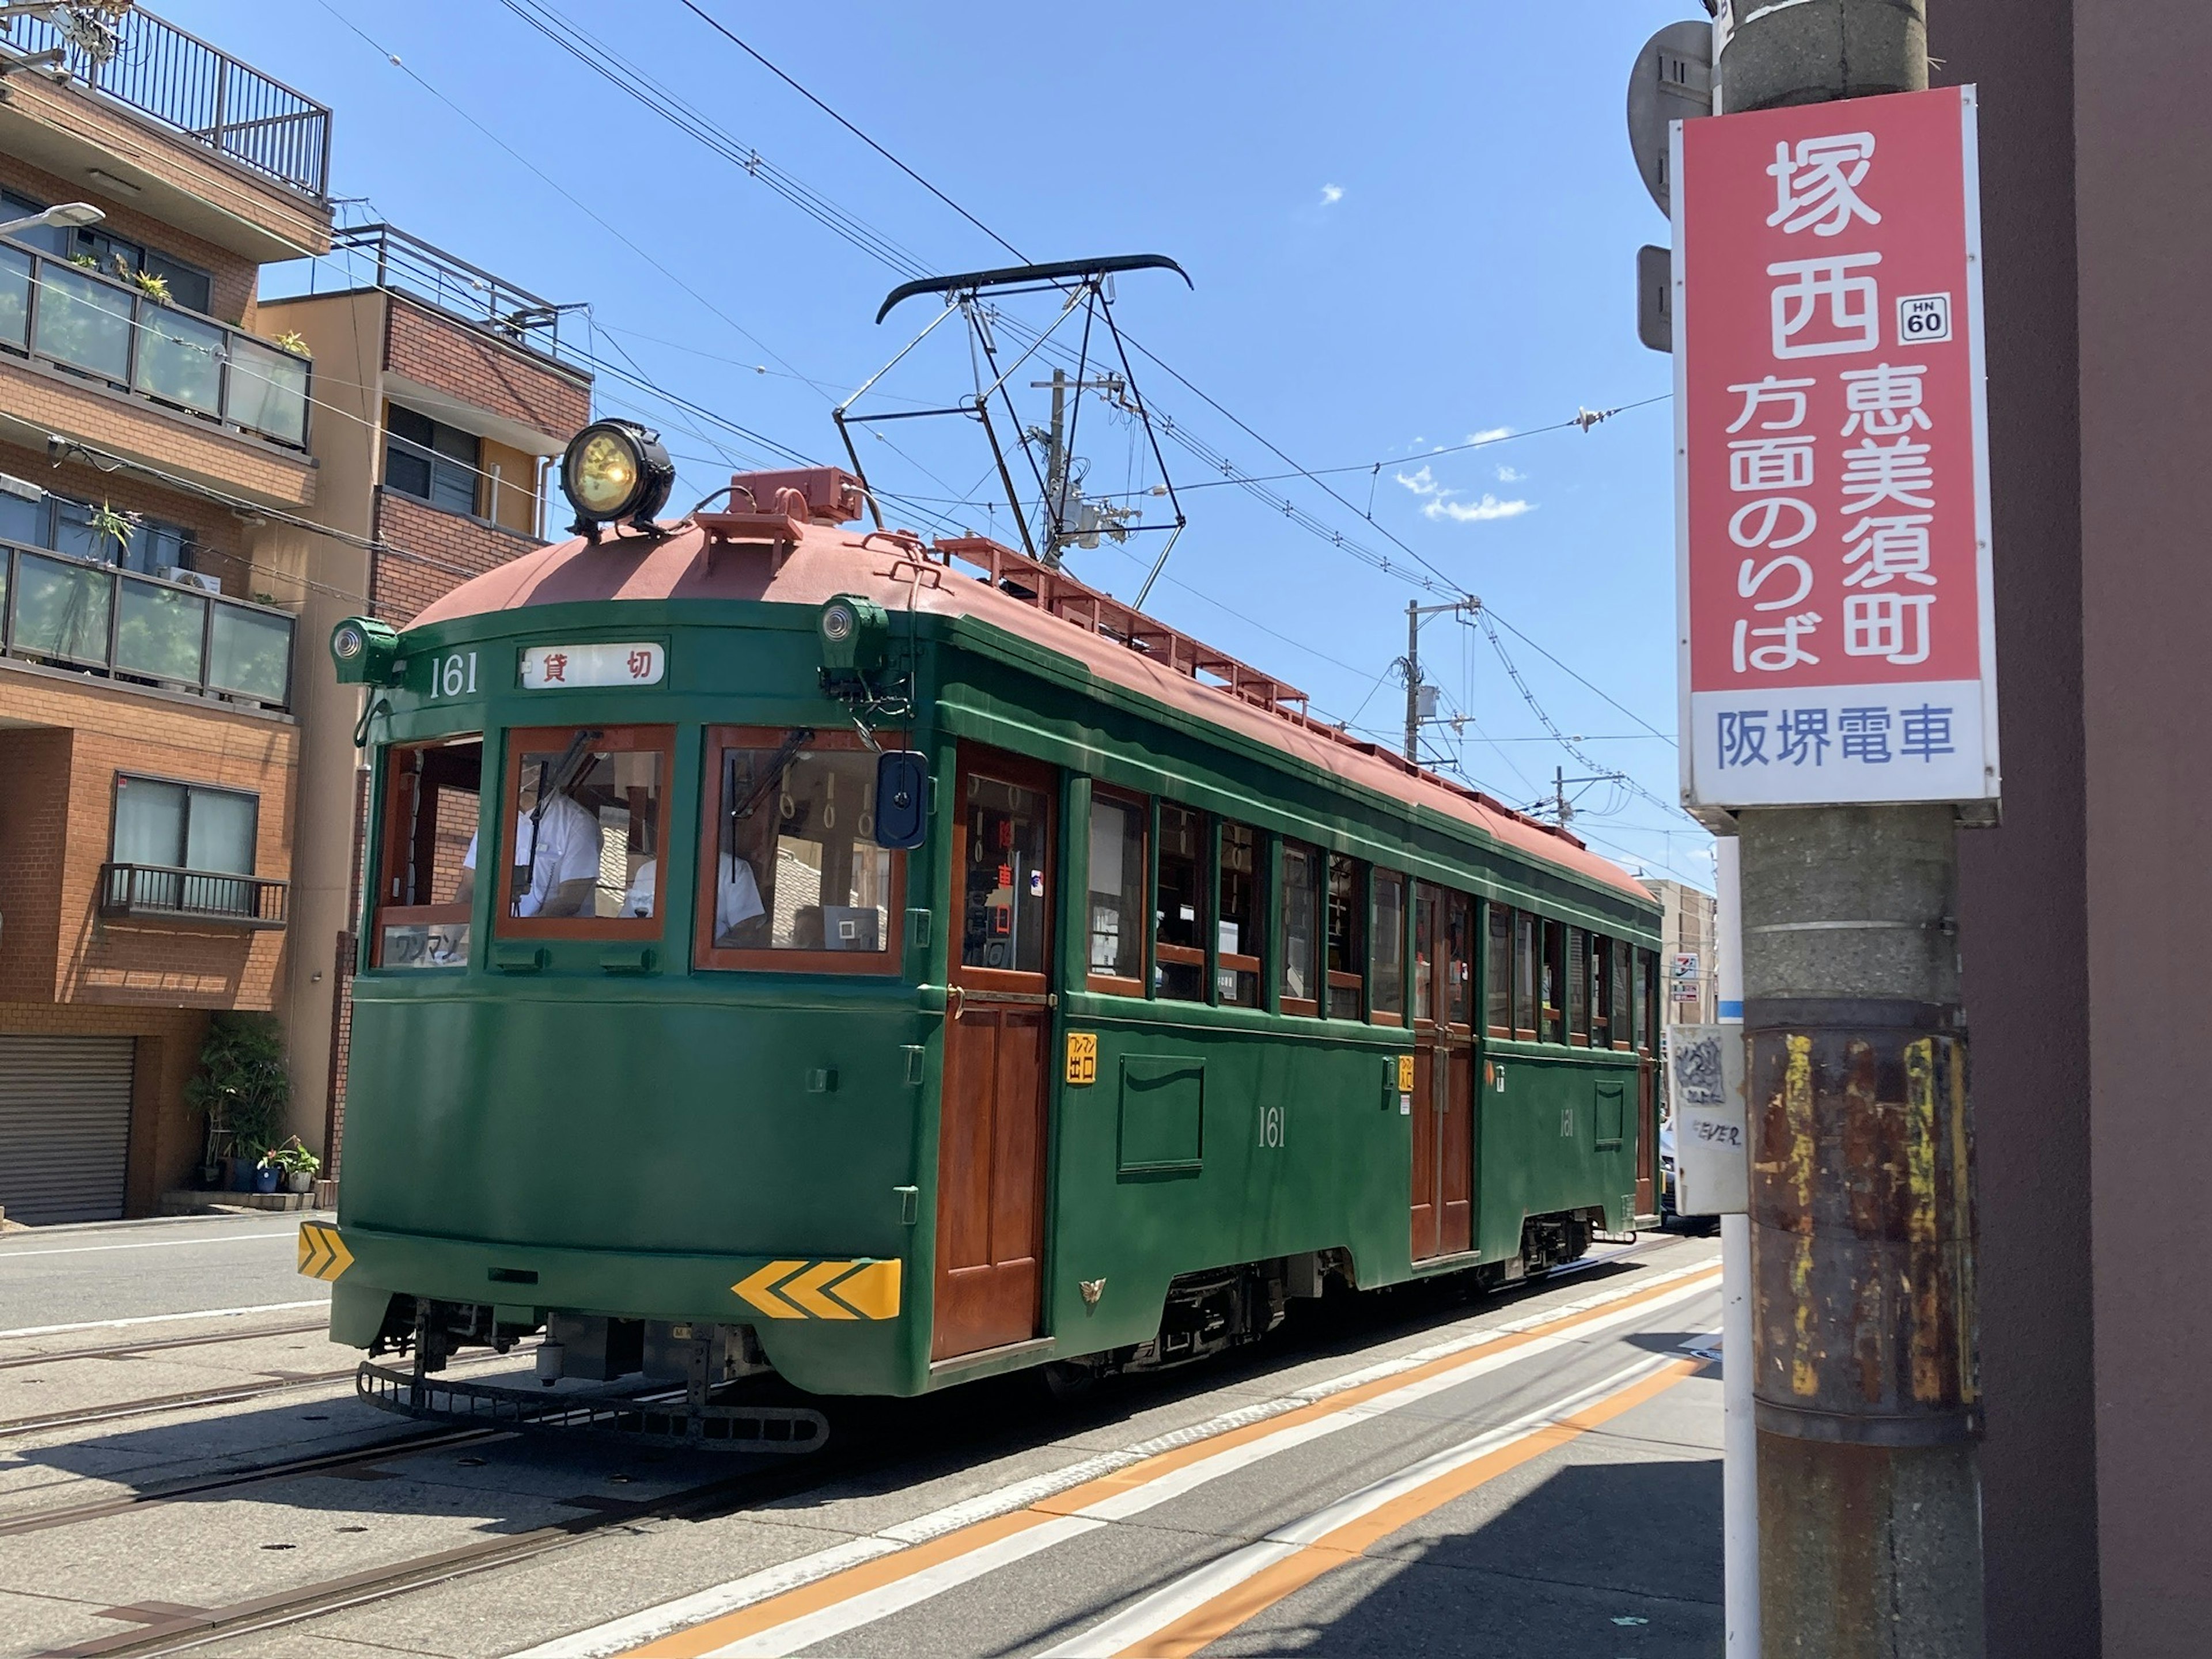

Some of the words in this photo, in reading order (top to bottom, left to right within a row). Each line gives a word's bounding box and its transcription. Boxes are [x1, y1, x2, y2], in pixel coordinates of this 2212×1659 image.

[1766, 131, 1883, 360] 塚西
[1907, 313, 1941, 333] 60
[1914, 301, 1934, 312] HN
[1725, 376, 1823, 673] 方面のりば
[1840, 362, 1937, 665] 恵美須町
[430, 652, 477, 699] 161
[1717, 703, 1955, 770] 阪堺電車
[1070, 1056, 1093, 1080] 出口
[1259, 1106, 1285, 1147] 161
